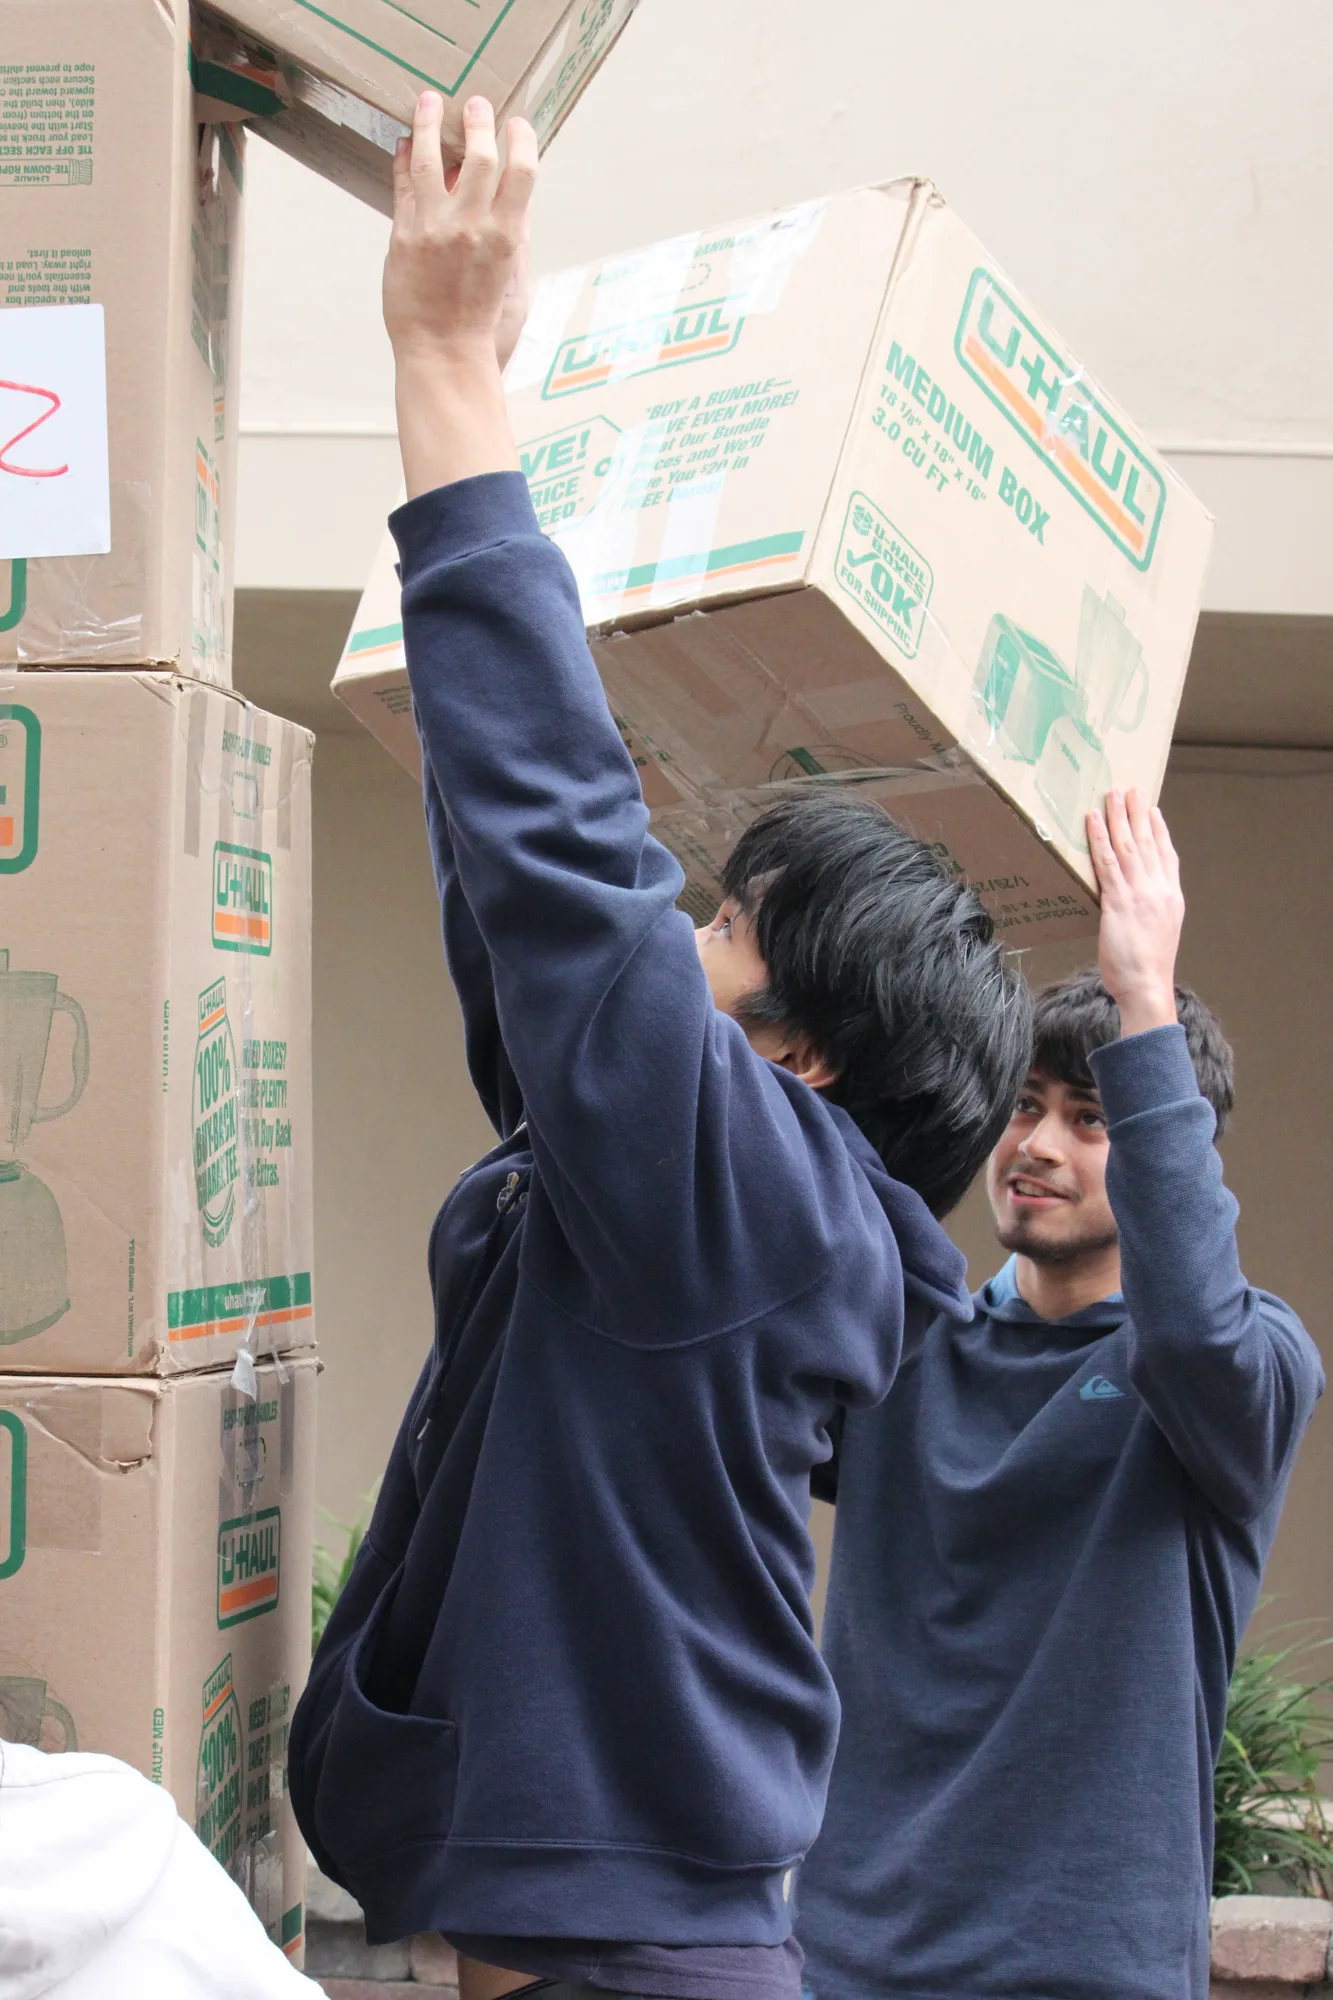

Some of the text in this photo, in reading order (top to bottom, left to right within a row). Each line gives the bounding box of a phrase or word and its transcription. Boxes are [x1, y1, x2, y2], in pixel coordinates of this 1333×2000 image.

[26, 63, 60, 73] prevent
[63, 64, 72, 72] to
[74, 63, 95, 72] rope
[3, 76, 95, 85] Secure each section
[9, 88, 23, 96] the
[26, 87, 57, 96] toward
[60, 86, 95, 96] upward
[3, 100, 17, 109] the
[20, 99, 43, 109] build
[45, 99, 65, 109] then
[2, 109, 94, 120] on the bottom (from
[31, 122, 45, 131] the
[48, 121, 68, 131] with
[70, 121, 93, 131] Start
[10, 134, 19, 142] in
[22, 133, 46, 143] truck
[49, 132, 68, 141] your
[71, 133, 93, 142] Load
[25, 146, 52, 155] EACH
[56, 146, 74, 155] OFF
[78, 146, 93, 155] TIE
[23, 164, 70, 174] TIE-DOWN
[27, 249, 92, 259] unload it first.
[6, 261, 13, 270] it
[16, 261, 38, 270] Load
[40, 260, 67, 269] away.
[69, 260, 92, 270] right
[17, 271, 42, 282] you'll
[44, 272, 92, 282] essentials
[8, 284, 91, 294] with the tools and
[5, 295, 22, 305] box
[24, 295, 57, 305] special
[67, 295, 91, 305] Pack
[687, 395, 701, 411] A
[690, 403, 737, 428] EVEN
[739, 389, 800, 418] MORE!
[975, 292, 1148, 528] U-HAUL
[679, 428, 708, 447] Our
[713, 417, 771, 441] Bundle
[693, 446, 717, 463] and
[723, 432, 764, 459] We'll
[879, 383, 897, 408] 18
[921, 428, 932, 445] x
[930, 436, 957, 465] 18"
[952, 466, 964, 482] x
[965, 476, 989, 503] 16"
[885, 339, 1051, 547] MEDIUM BOX
[519, 428, 591, 479] VE!
[871, 405, 951, 494] 3.0 CU FT
[667, 468, 695, 486] You
[700, 458, 728, 477] $20
[731, 454, 750, 471] in
[529, 475, 581, 508] RICE
[874, 521, 928, 588] U-HAUL
[871, 536, 925, 600] BOXES
[870, 562, 918, 631] OK
[840, 563, 912, 649] FOR SHIPPING
[893, 702, 935, 741] Proudly
[216, 859, 270, 915] U-HAUL
[1035, 906, 1090, 923] Product
[200, 985, 225, 1020] U-HAUL
[262, 1040, 288, 1070] BOXES?
[197, 1030, 231, 1114] 100%
[261, 1079, 288, 1108] PLENTY!
[196, 1096, 236, 1169] BUY-BACK
[261, 1118, 275, 1153] Buy
[275, 1118, 292, 1148] Back
[256, 1158, 280, 1187] Extras.
[222, 1525, 277, 1586] U-HAUL
[204, 1663, 231, 1708] U-HAUL
[153, 1707, 164, 1740] MED
[201, 1705, 237, 1793] 100%
